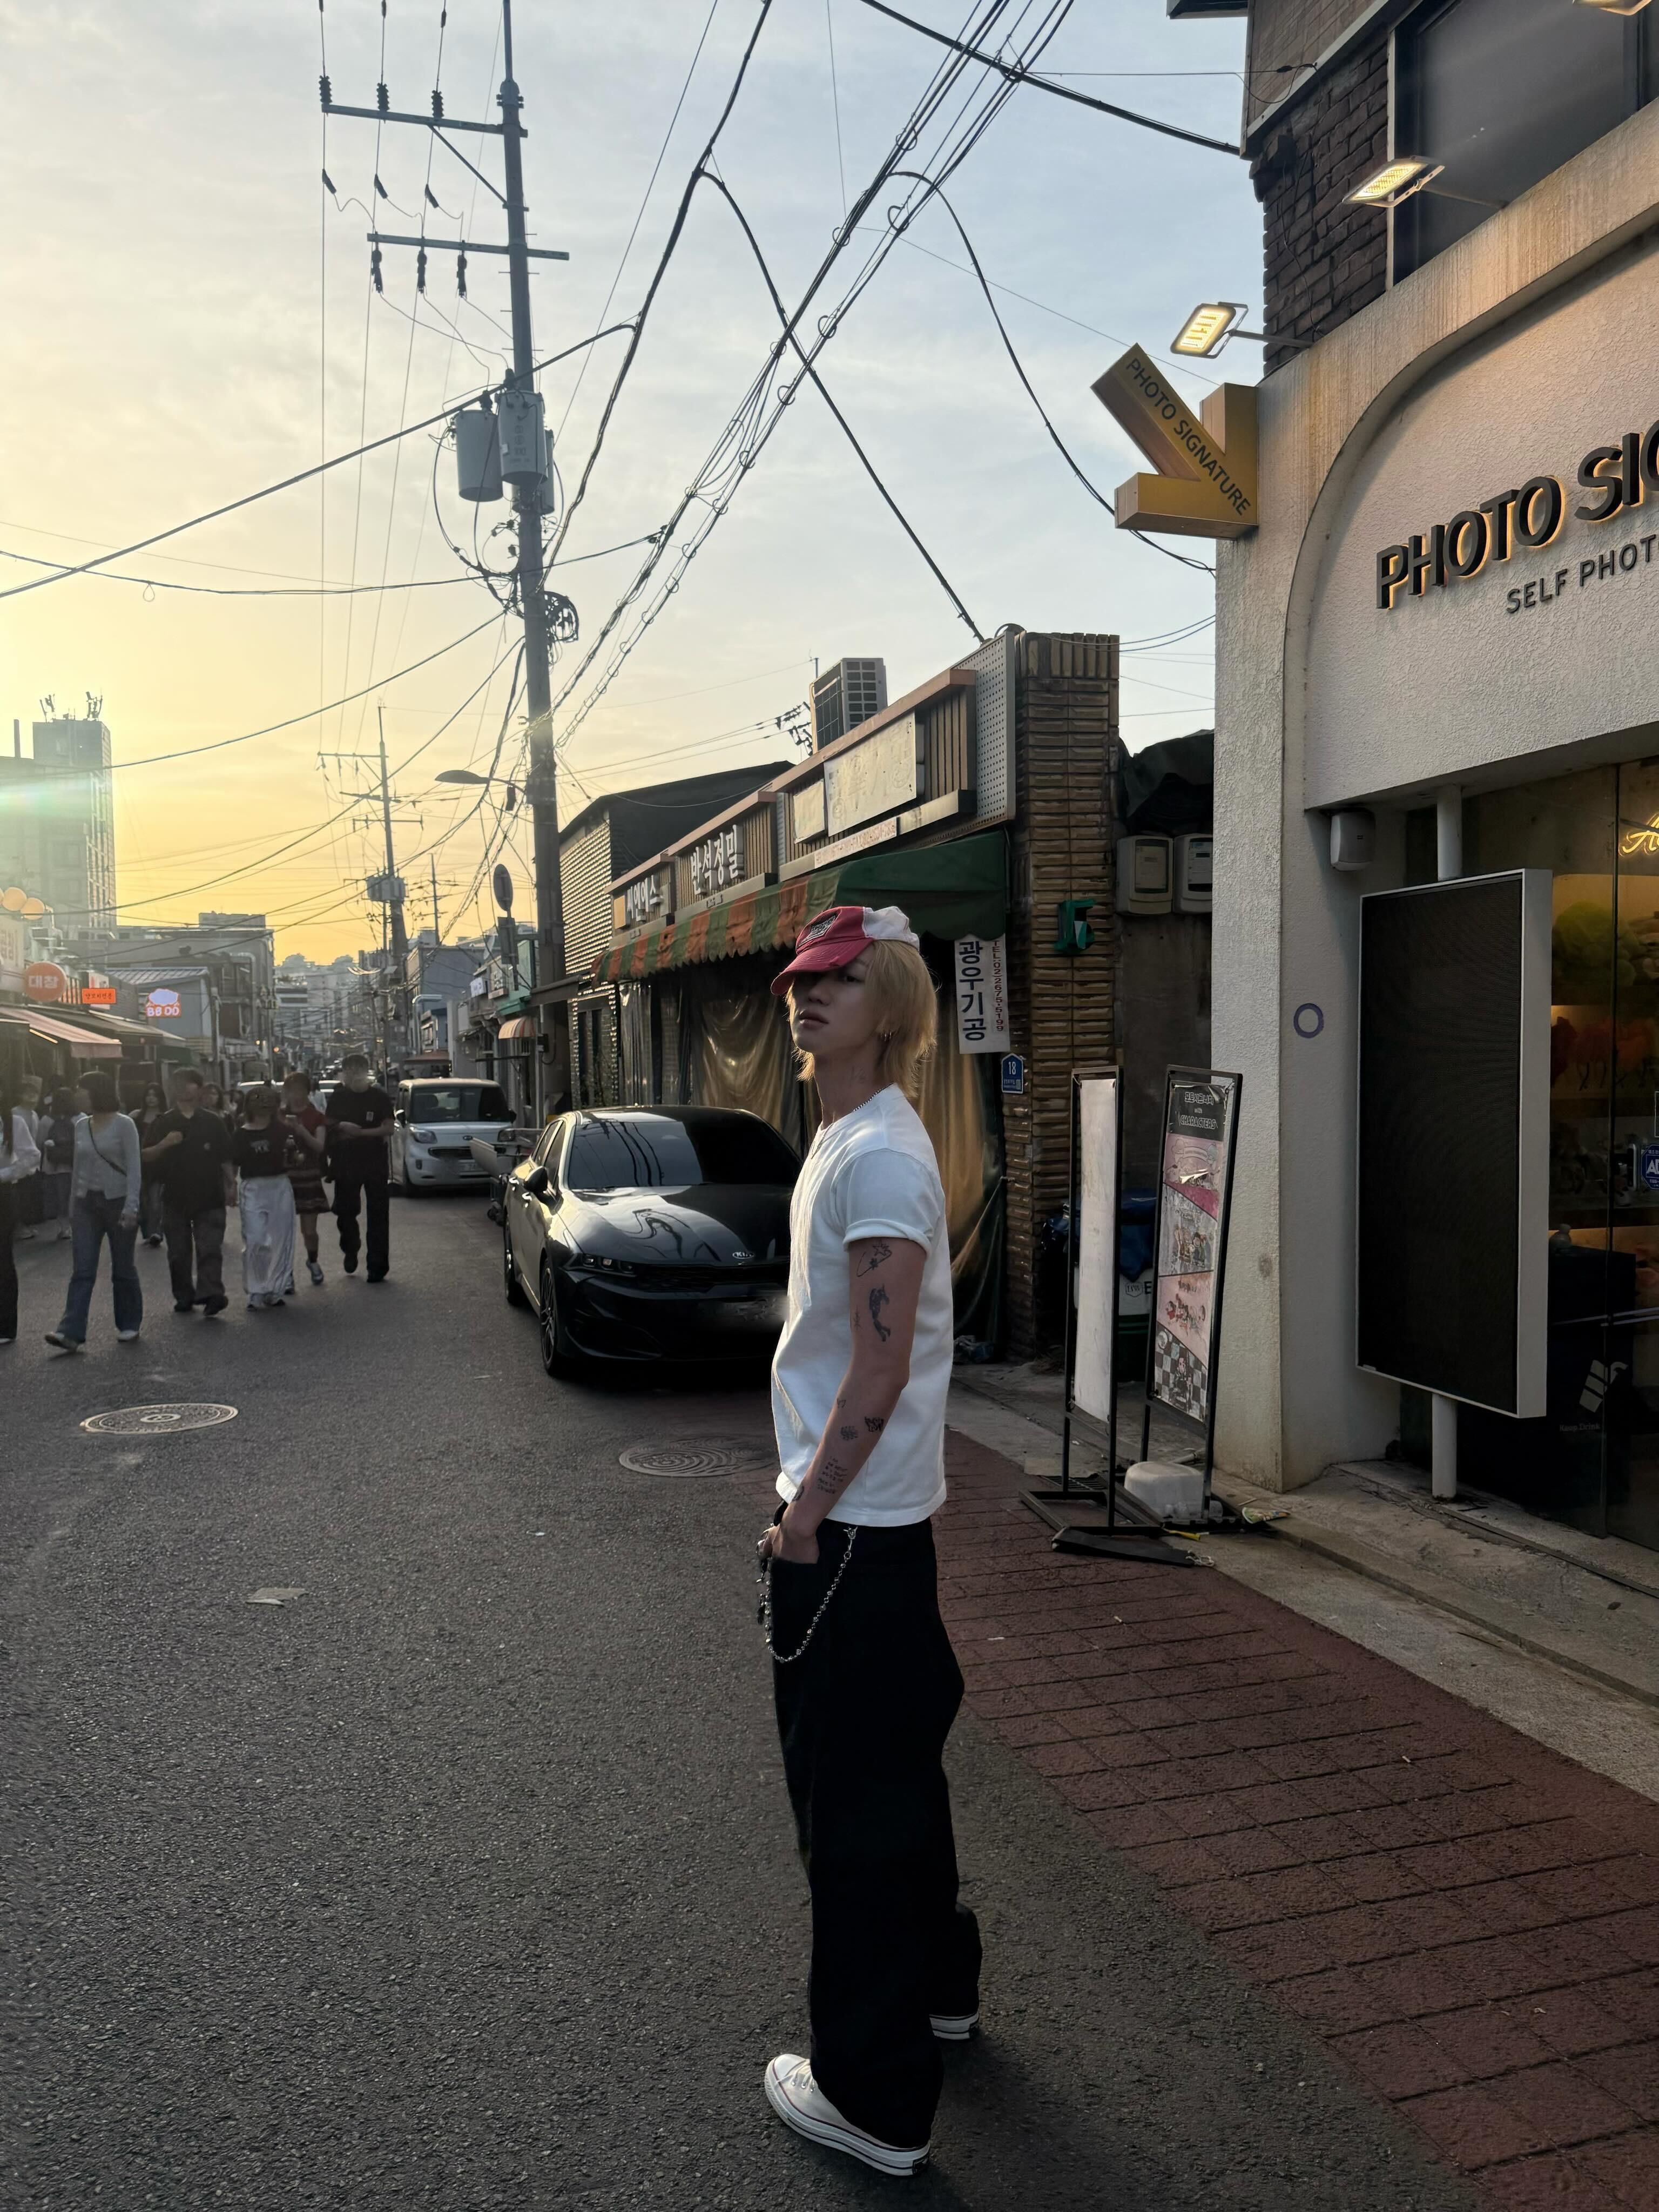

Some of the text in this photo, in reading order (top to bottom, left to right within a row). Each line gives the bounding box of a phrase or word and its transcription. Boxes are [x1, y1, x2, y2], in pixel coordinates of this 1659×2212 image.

[1126, 358, 1251, 516] PHOTO SIGNATURE
[1376, 475, 1563, 609] PHOTO
[1506, 534, 1659, 615] SELF PHOT
[691, 824, 740, 895] 반석정밀
[959, 940, 987, 1041] 광우기공
[1008, 1061, 1016, 1075] 18
[1180, 1114, 1216, 1130] CHARACTERS
